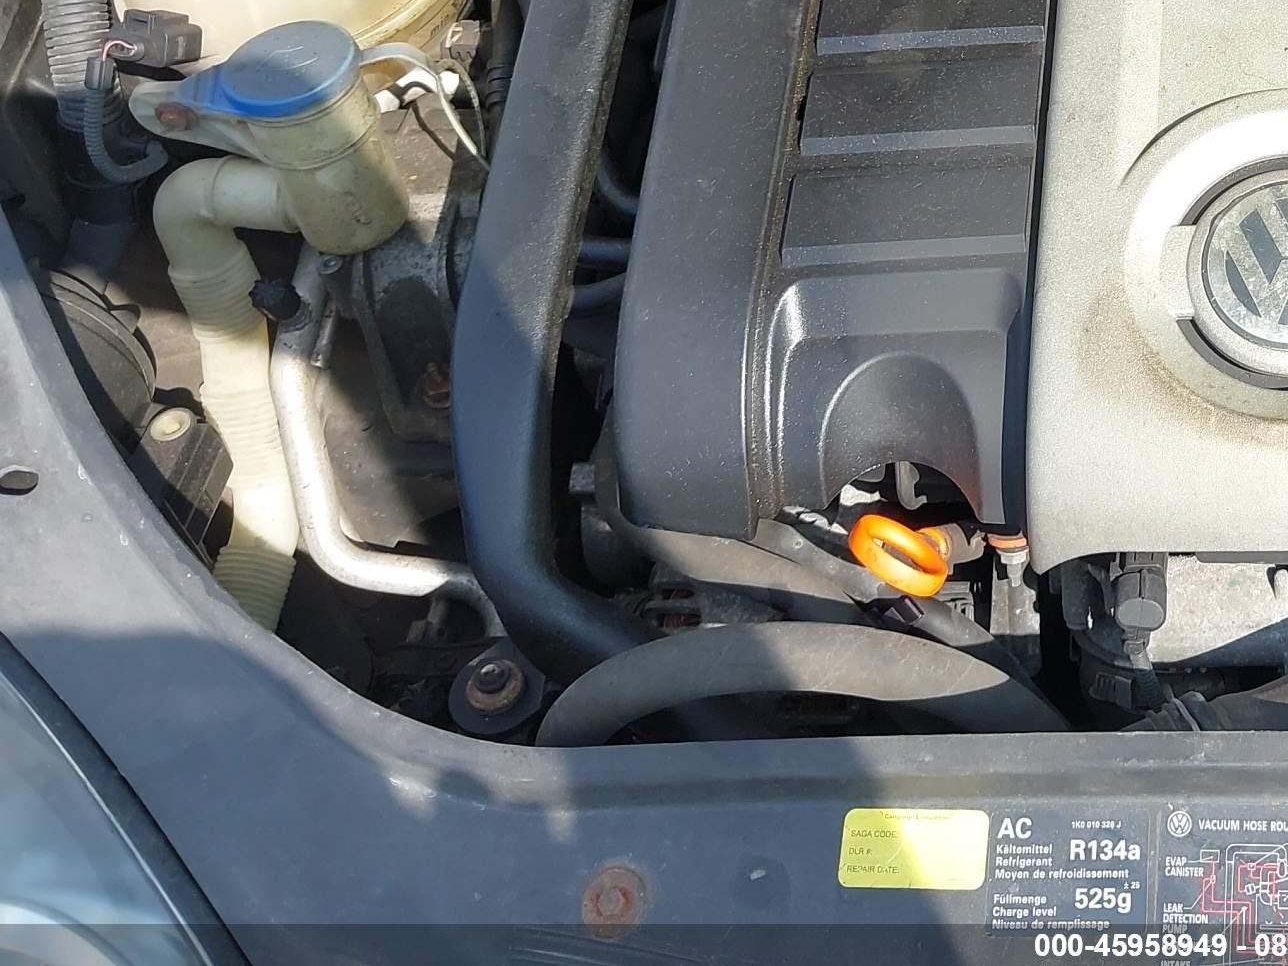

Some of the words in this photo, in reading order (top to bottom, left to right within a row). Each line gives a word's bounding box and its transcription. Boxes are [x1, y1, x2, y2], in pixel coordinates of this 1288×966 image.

[997, 817, 1033, 839] AC
[1198, 819, 1240, 832] VACUUM
[1243, 819, 1268, 832] HOSE
[996, 843, 1053, 855] Kältemittel
[1069, 839, 1141, 861] R134a
[995, 857, 1053, 869] Refrigerant
[1165, 856, 1188, 866] EVAP
[994, 869, 1030, 881] Moyen
[1033, 869, 1045, 879] de
[1048, 868, 1130, 879] refroidissement
[1164, 866, 1204, 877] CANISTER
[1130, 882, 1141, 890] 25
[993, 893, 1047, 905] Füllmenge
[1074, 887, 1132, 914] 525g
[992, 906, 1029, 919] Charge
[1032, 906, 1057, 917] level
[1163, 903, 1184, 914] LEAK
[991, 919, 1028, 930] Niveau
[1030, 919, 1044, 930] de
[1047, 918, 1110, 931] remplissage
[1163, 914, 1209, 924] DETECTION
[1162, 924, 1188, 934] PUMP
